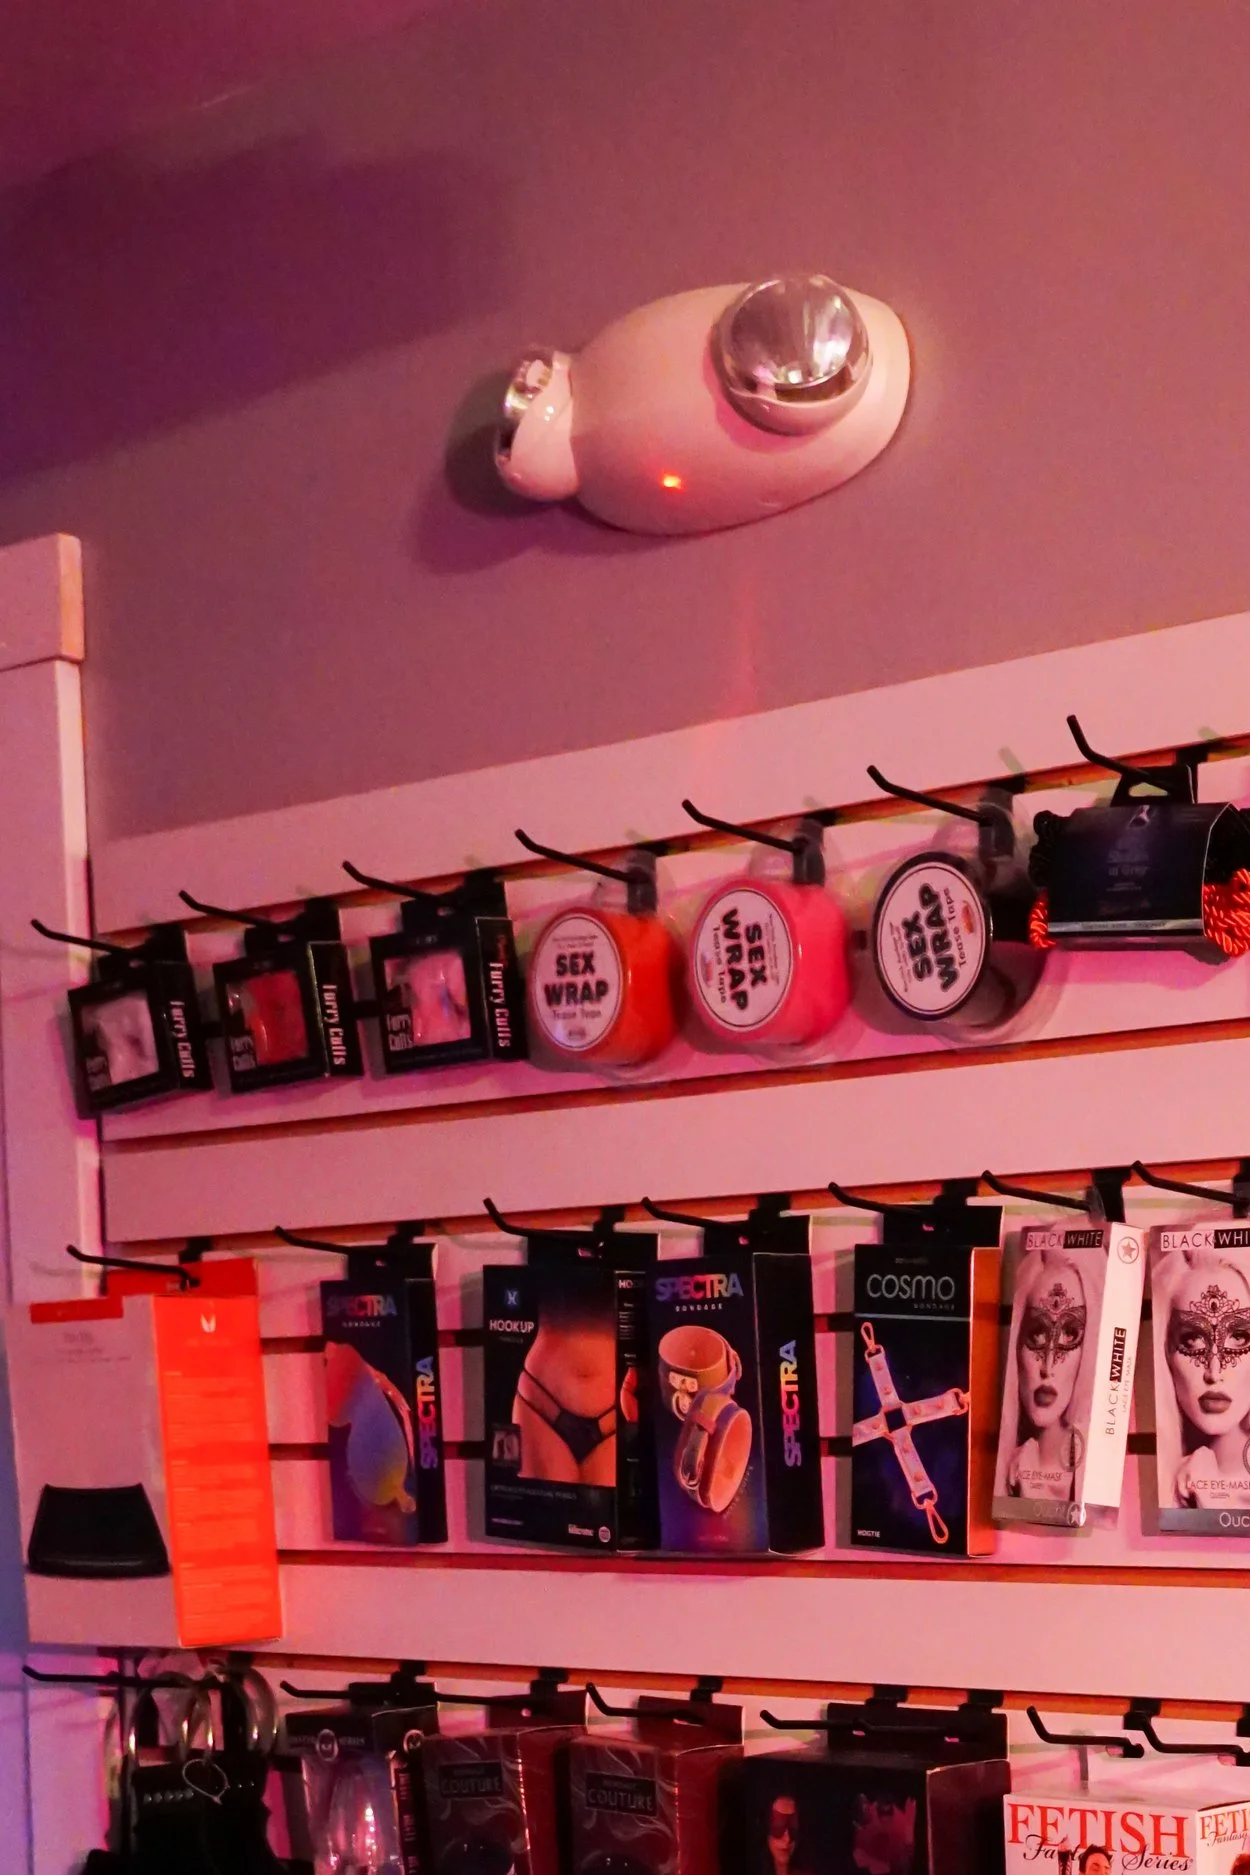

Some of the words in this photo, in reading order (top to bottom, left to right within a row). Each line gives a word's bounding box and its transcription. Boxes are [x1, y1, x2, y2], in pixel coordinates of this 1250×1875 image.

[901, 911, 934, 982] SEX
[919, 883, 960, 993] WRAP
[556, 952, 595, 977] SEX
[722, 907, 748, 1011] WRAP
[745, 923, 768, 987] SEX
[544, 980, 609, 1006] WRAP
[1067, 1231, 1102, 1247] WHITE
[1162, 1232, 1213, 1249] BLACK
[655, 1272, 744, 1302] SPECTRA
[326, 1294, 397, 1317] SPECTRA
[489, 1319, 535, 1334] HOOKUP
[1111, 1328, 1126, 1381] WHITE
[416, 1355, 438, 1470] SPECTRA
[779, 1339, 801, 1467] SPECTRA
[857, 1529, 881, 1538] HOGTIE
[440, 1777, 502, 1794] COUTURE
[587, 1788, 655, 1812] COUTURE
[1007, 1802, 1189, 1858] FETISH
[1121, 1844, 1191, 1875] Series
